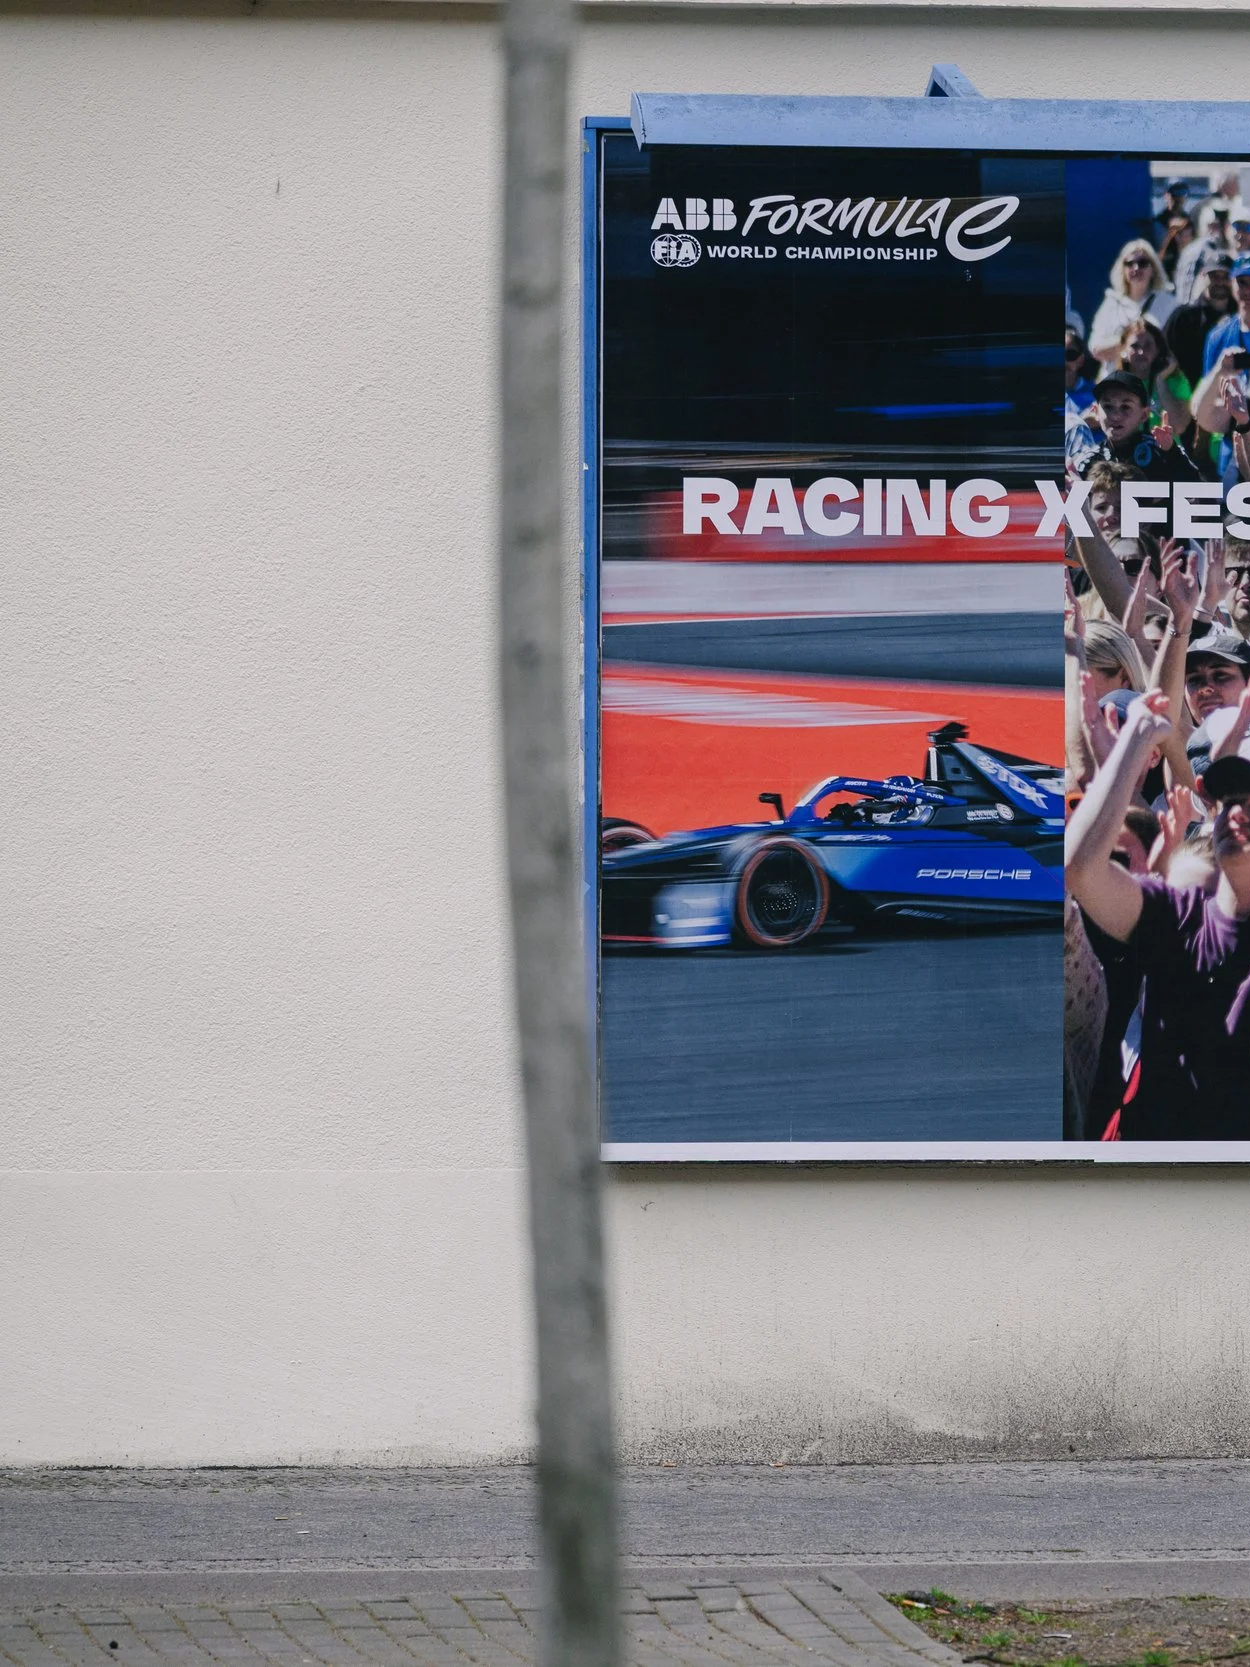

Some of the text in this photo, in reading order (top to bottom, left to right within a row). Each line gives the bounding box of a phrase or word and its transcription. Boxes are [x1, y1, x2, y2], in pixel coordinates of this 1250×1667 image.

[651, 198, 737, 231] ABB
[741, 195, 951, 239] FORMULA
[707, 245, 777, 259] WORLD
[785, 246, 938, 261] CHAMPIONSHIP
[683, 477, 1010, 538] RACING
[1034, 480, 1095, 537] X
[916, 868, 1032, 880] PORSCHE
